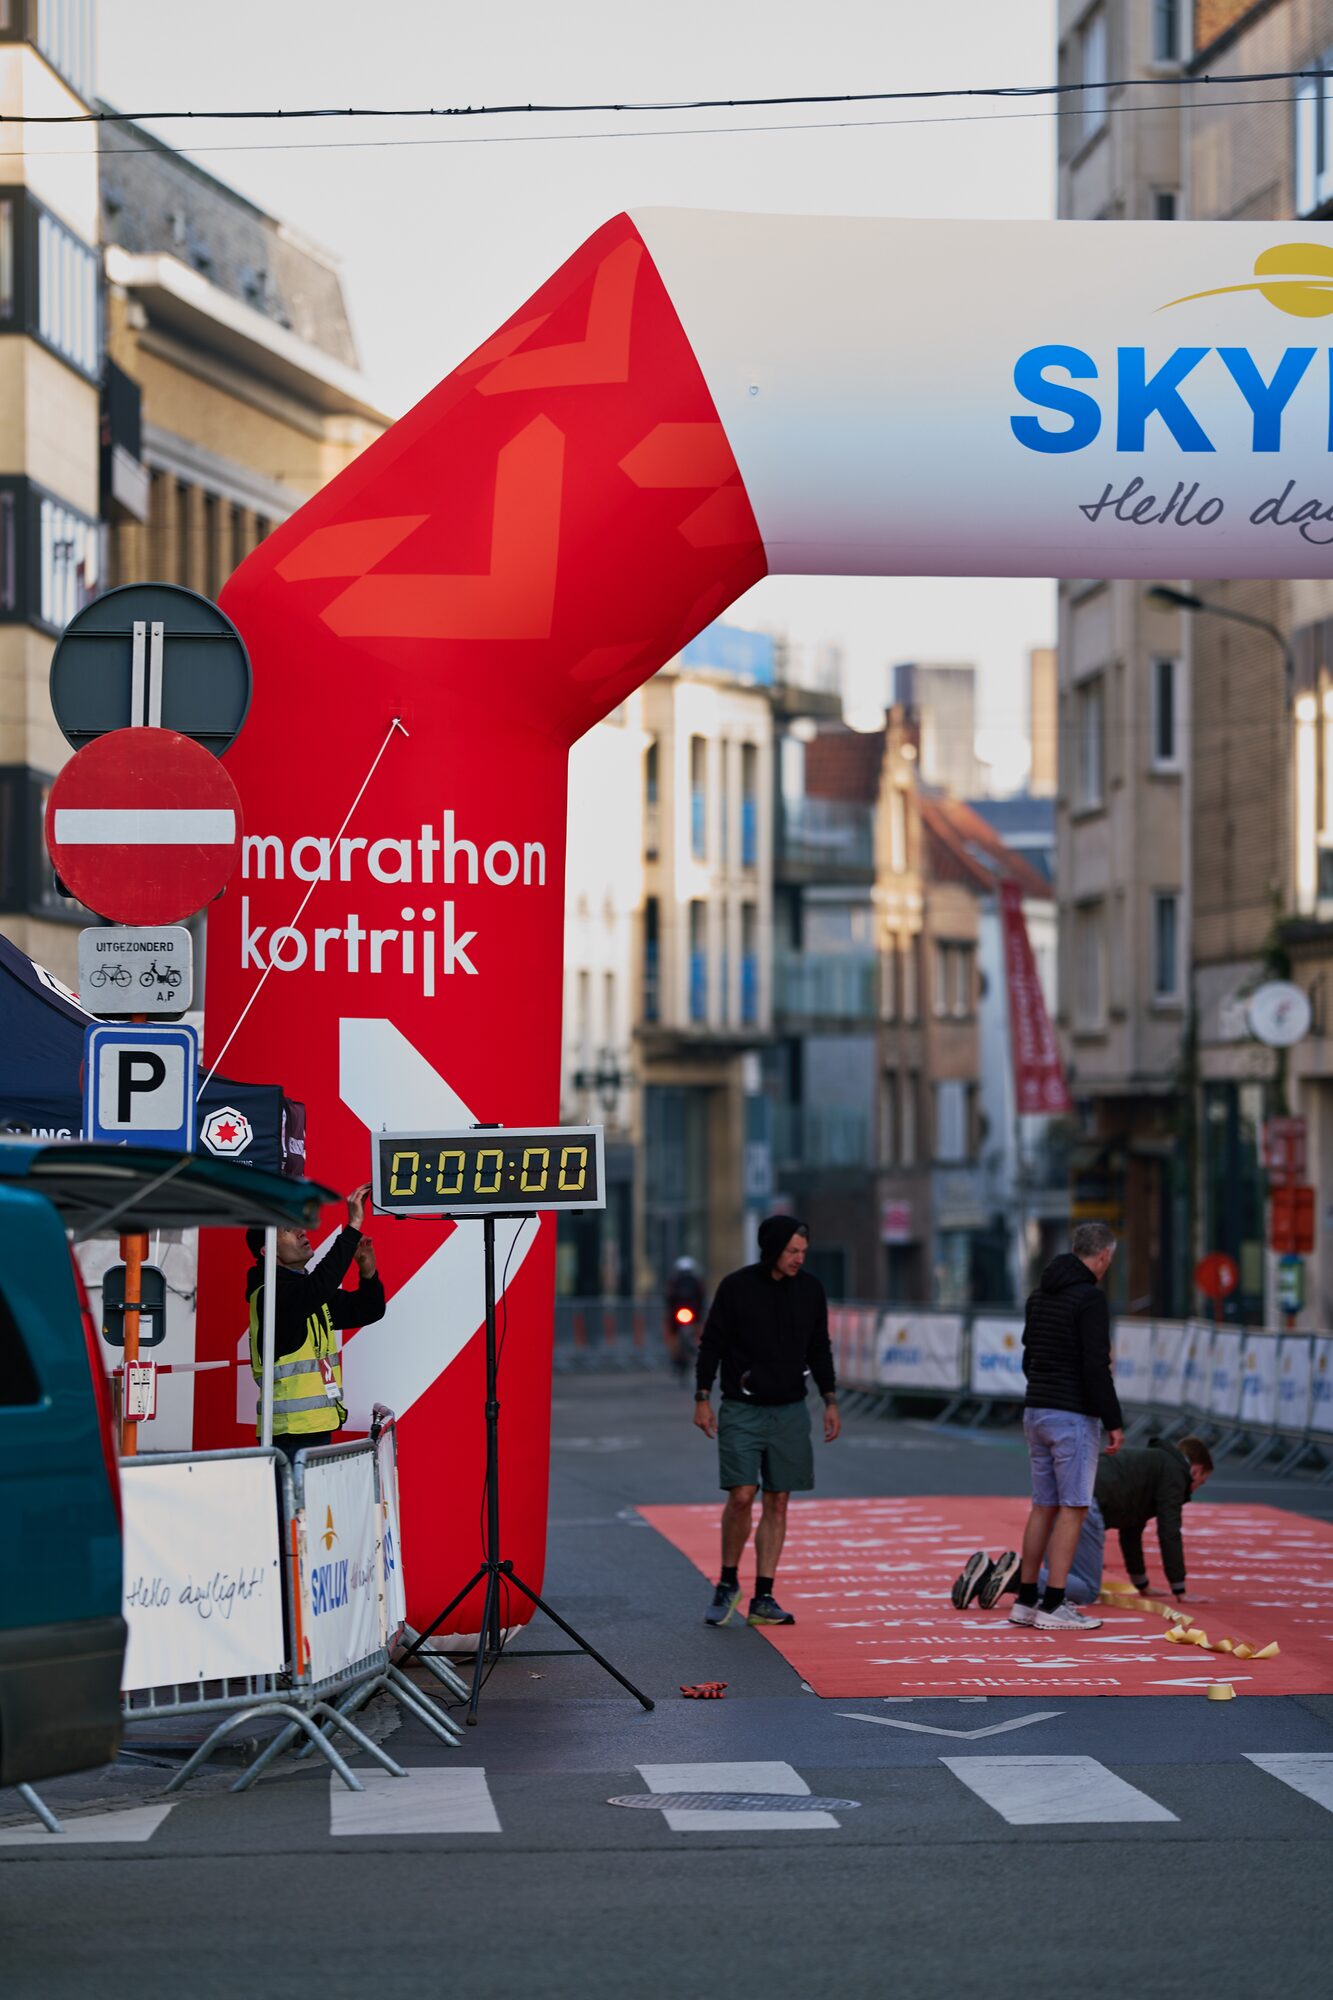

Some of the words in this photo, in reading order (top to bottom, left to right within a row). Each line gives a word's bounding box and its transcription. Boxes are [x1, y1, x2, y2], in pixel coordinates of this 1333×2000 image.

[1010, 344, 1333, 454] SKY
[1078, 476, 1224, 526] Hello
[241, 810, 545, 886] marathon
[96, 942, 174, 952] UITGEZONDERD
[241, 896, 479, 997] kortrijk
[117, 1051, 166, 1123] P
[389, 1147, 588, 1196] 0:00:00
[126, 1577, 170, 1608] Hello
[178, 1567, 264, 1619] daylight!
